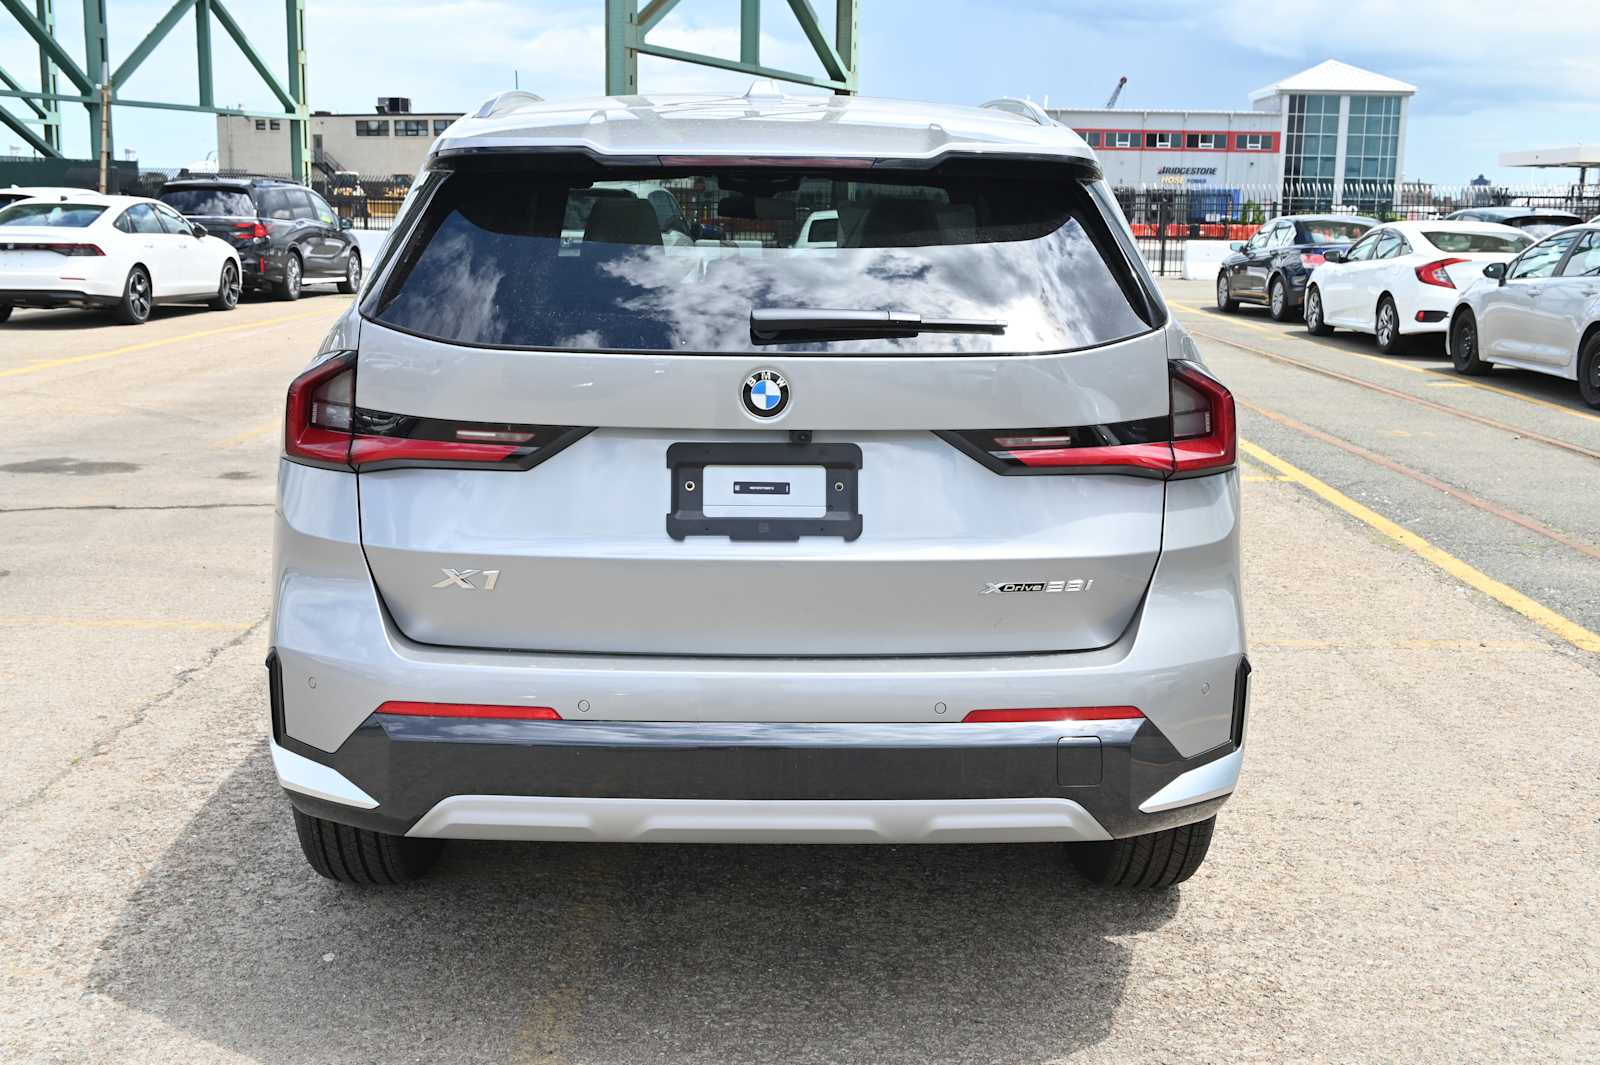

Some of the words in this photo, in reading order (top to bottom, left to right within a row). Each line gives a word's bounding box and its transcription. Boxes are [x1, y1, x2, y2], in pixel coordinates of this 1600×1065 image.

[1157, 166, 1218, 175] BRIDGESTONE
[747, 371, 787, 388] BMW
[432, 567, 500, 592] X1
